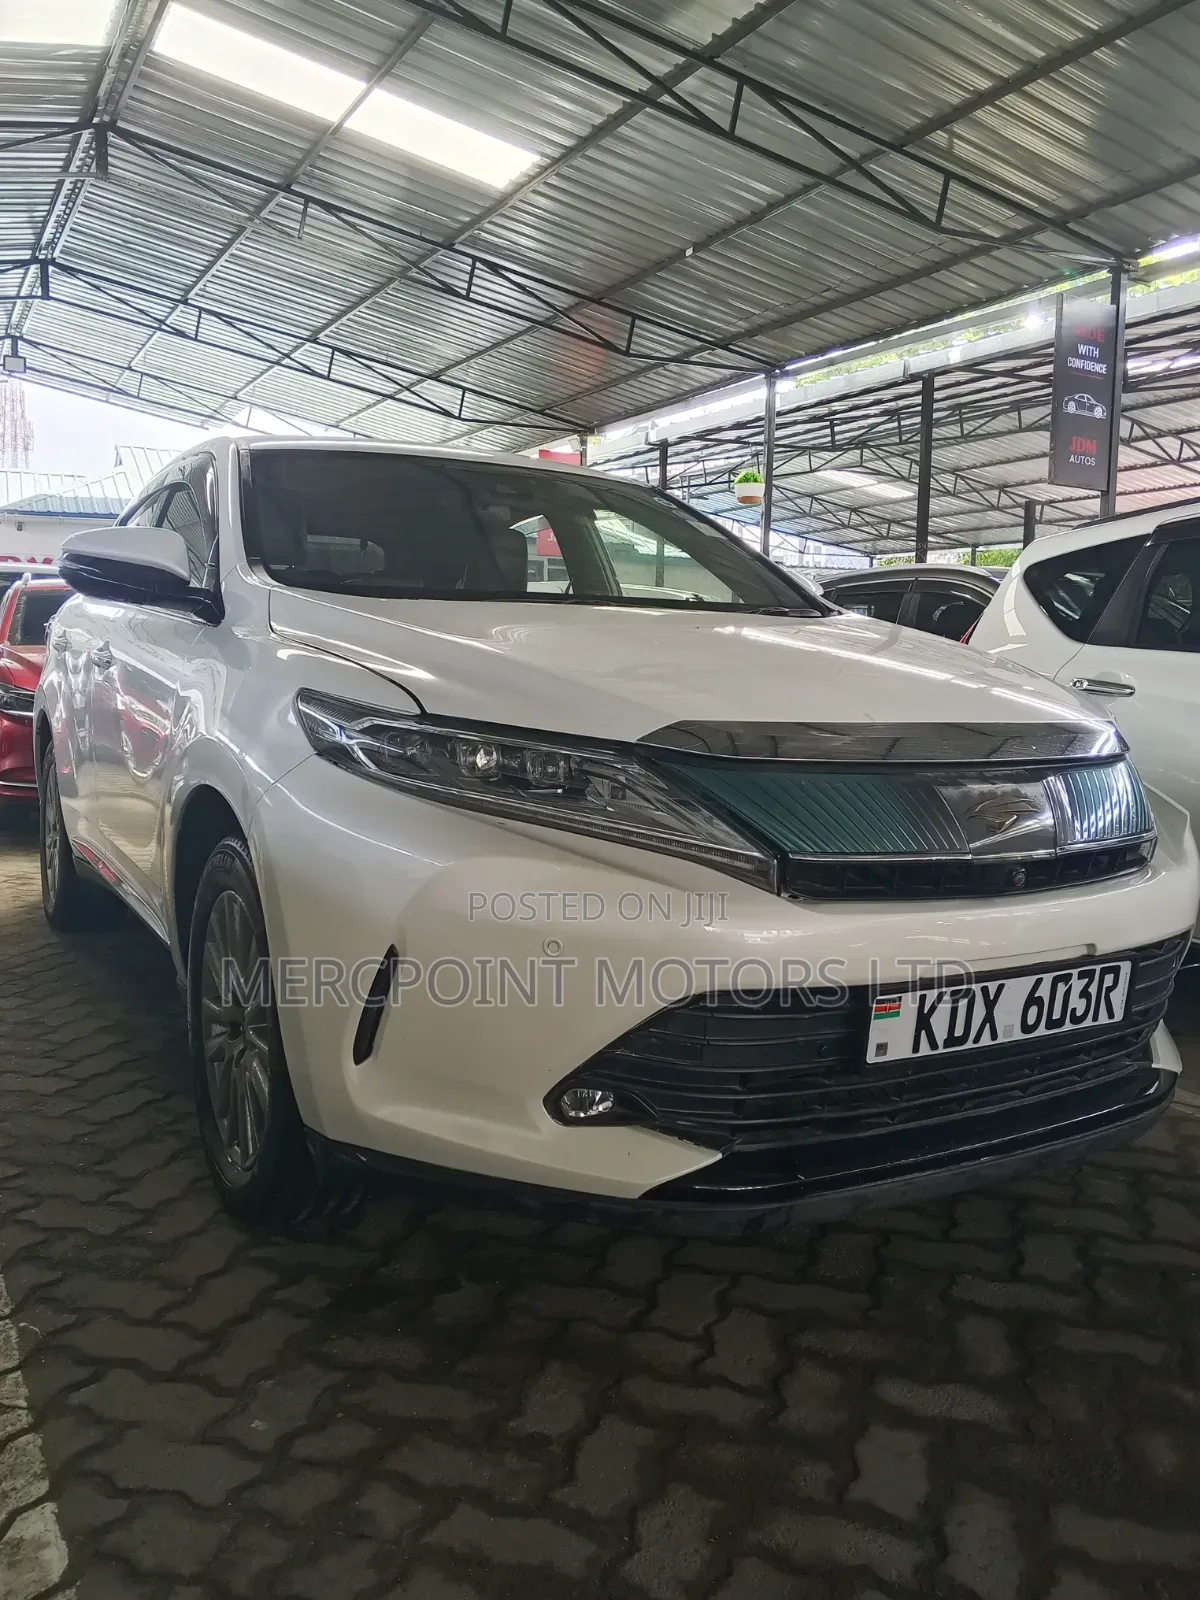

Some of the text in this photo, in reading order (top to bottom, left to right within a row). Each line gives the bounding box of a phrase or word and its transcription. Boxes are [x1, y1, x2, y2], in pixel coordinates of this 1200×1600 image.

[1077, 343, 1099, 358] WITH
[1067, 357, 1107, 374] CONFIDENCE
[1069, 436, 1097, 453] JDM
[1069, 455, 1096, 466] AUTOS
[912, 983, 1005, 1054] KDX
[1020, 965, 1122, 1034] 603R
